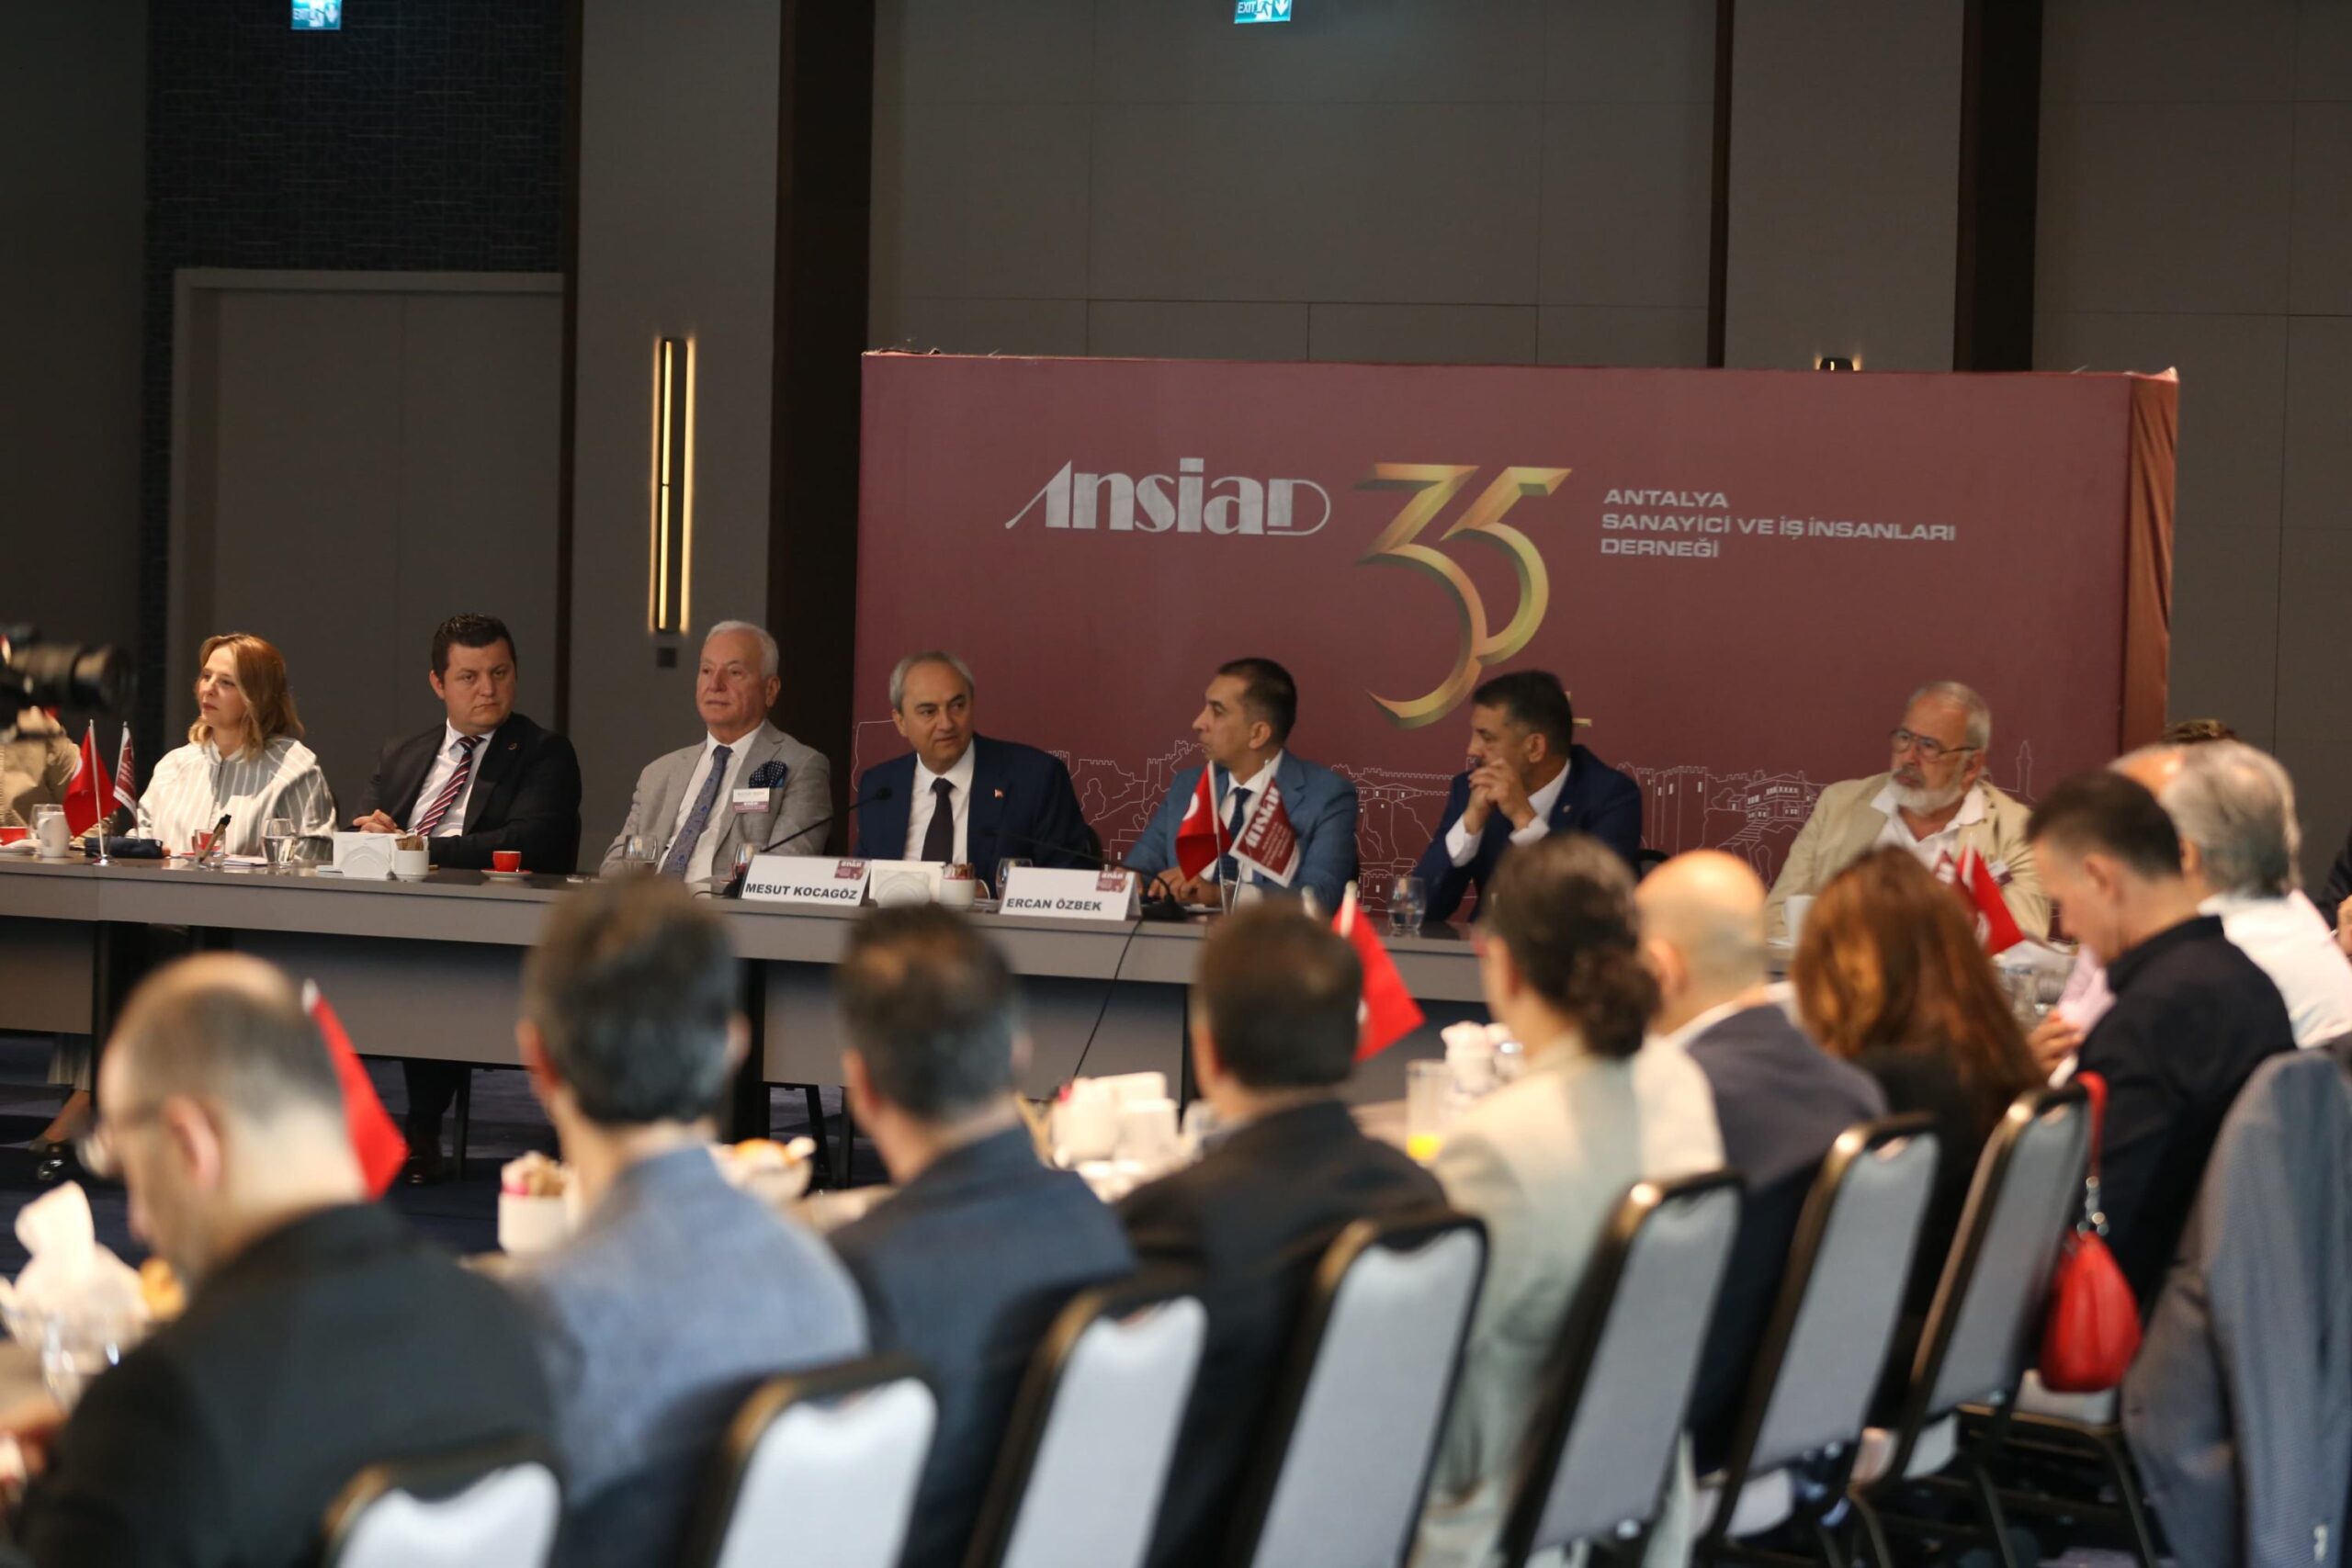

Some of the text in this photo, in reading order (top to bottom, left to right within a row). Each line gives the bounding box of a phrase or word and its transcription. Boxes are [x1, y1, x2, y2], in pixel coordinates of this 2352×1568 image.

[1237, 1, 1257, 14] EXIT
[1603, 489, 1729, 508] ANTALYA
[1601, 513, 1956, 541] SANAYİCİ VE İŞ İNSANLARI
[1600, 537, 1720, 558] DERNEĞİ
[1352, 463, 1572, 729] 35
[745, 883, 858, 900] MESUT KOCAGÖZ
[1006, 897, 1102, 912] ERCAN ÖZBEK
